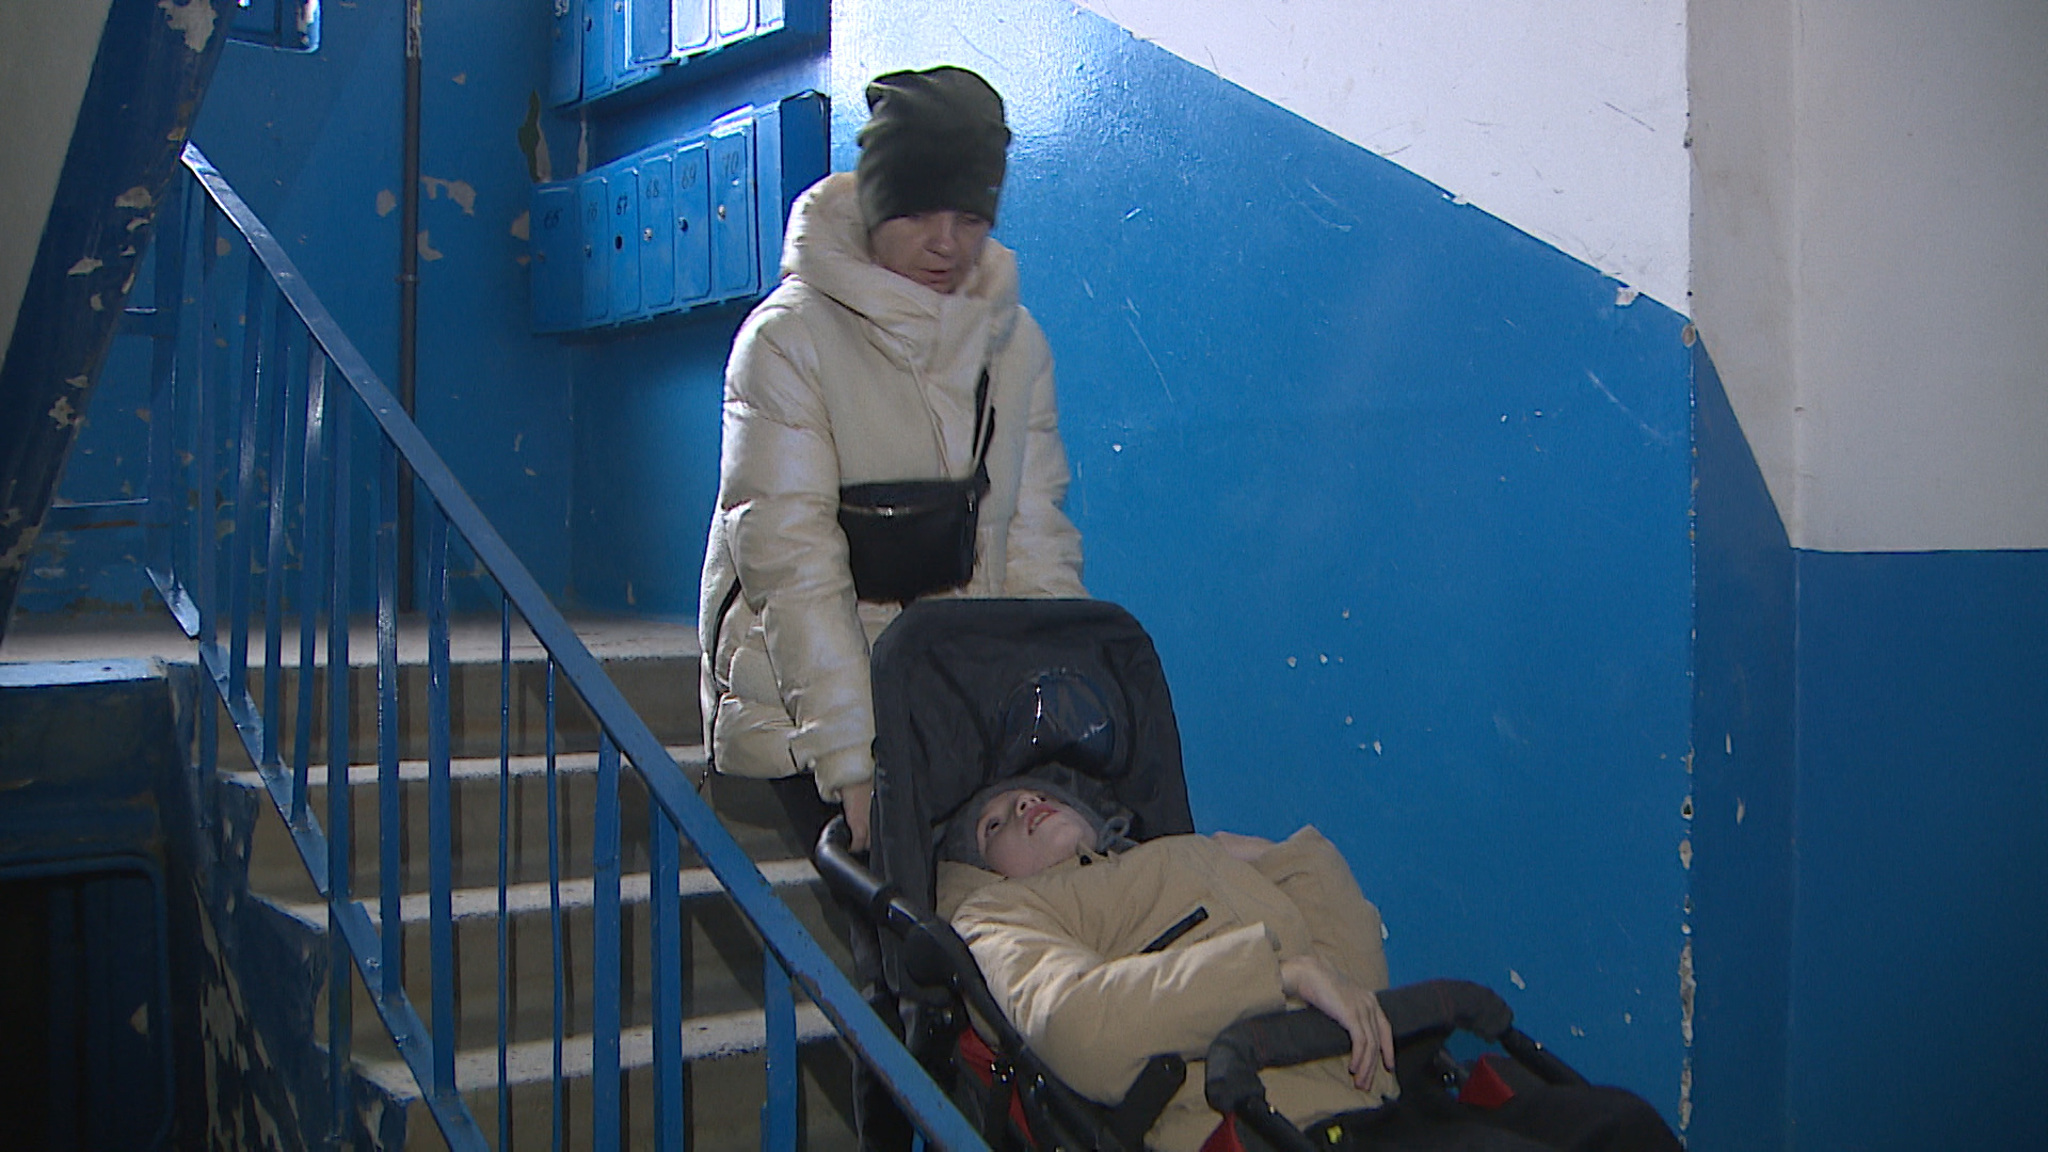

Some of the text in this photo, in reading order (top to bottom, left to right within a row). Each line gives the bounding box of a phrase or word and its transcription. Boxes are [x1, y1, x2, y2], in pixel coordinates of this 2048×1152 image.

[682, 162, 697, 190] 69
[722, 151, 739, 178] 70
[616, 195, 628, 215] 67
